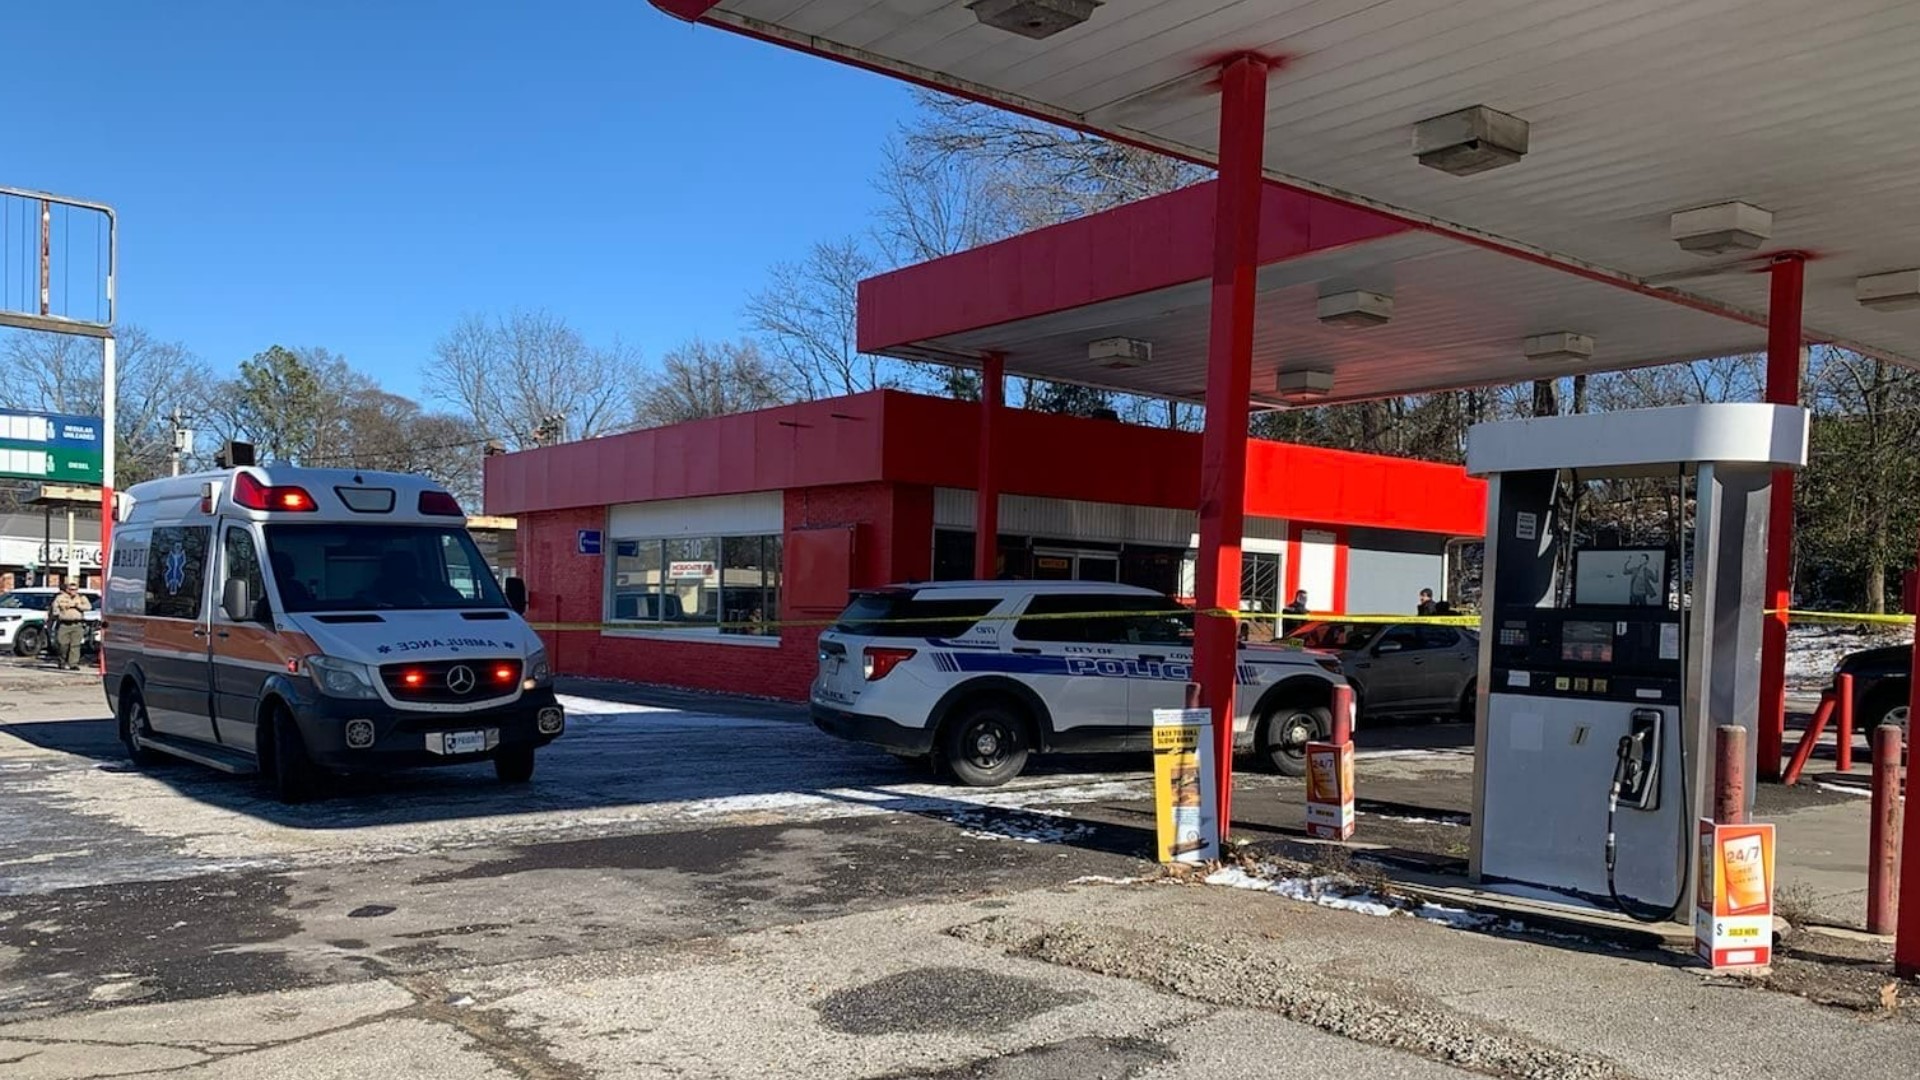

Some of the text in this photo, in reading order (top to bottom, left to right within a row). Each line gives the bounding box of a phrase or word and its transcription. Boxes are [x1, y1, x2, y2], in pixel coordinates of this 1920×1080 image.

[67, 462, 90, 470] DIESEL
[1065, 645, 1112, 655] CITY OF
[1066, 657, 1193, 680] POLIC
[1726, 846, 1760, 864] 24/7
[1716, 923, 1723, 937] $
[1728, 928, 1759, 937] SOLD HERE
